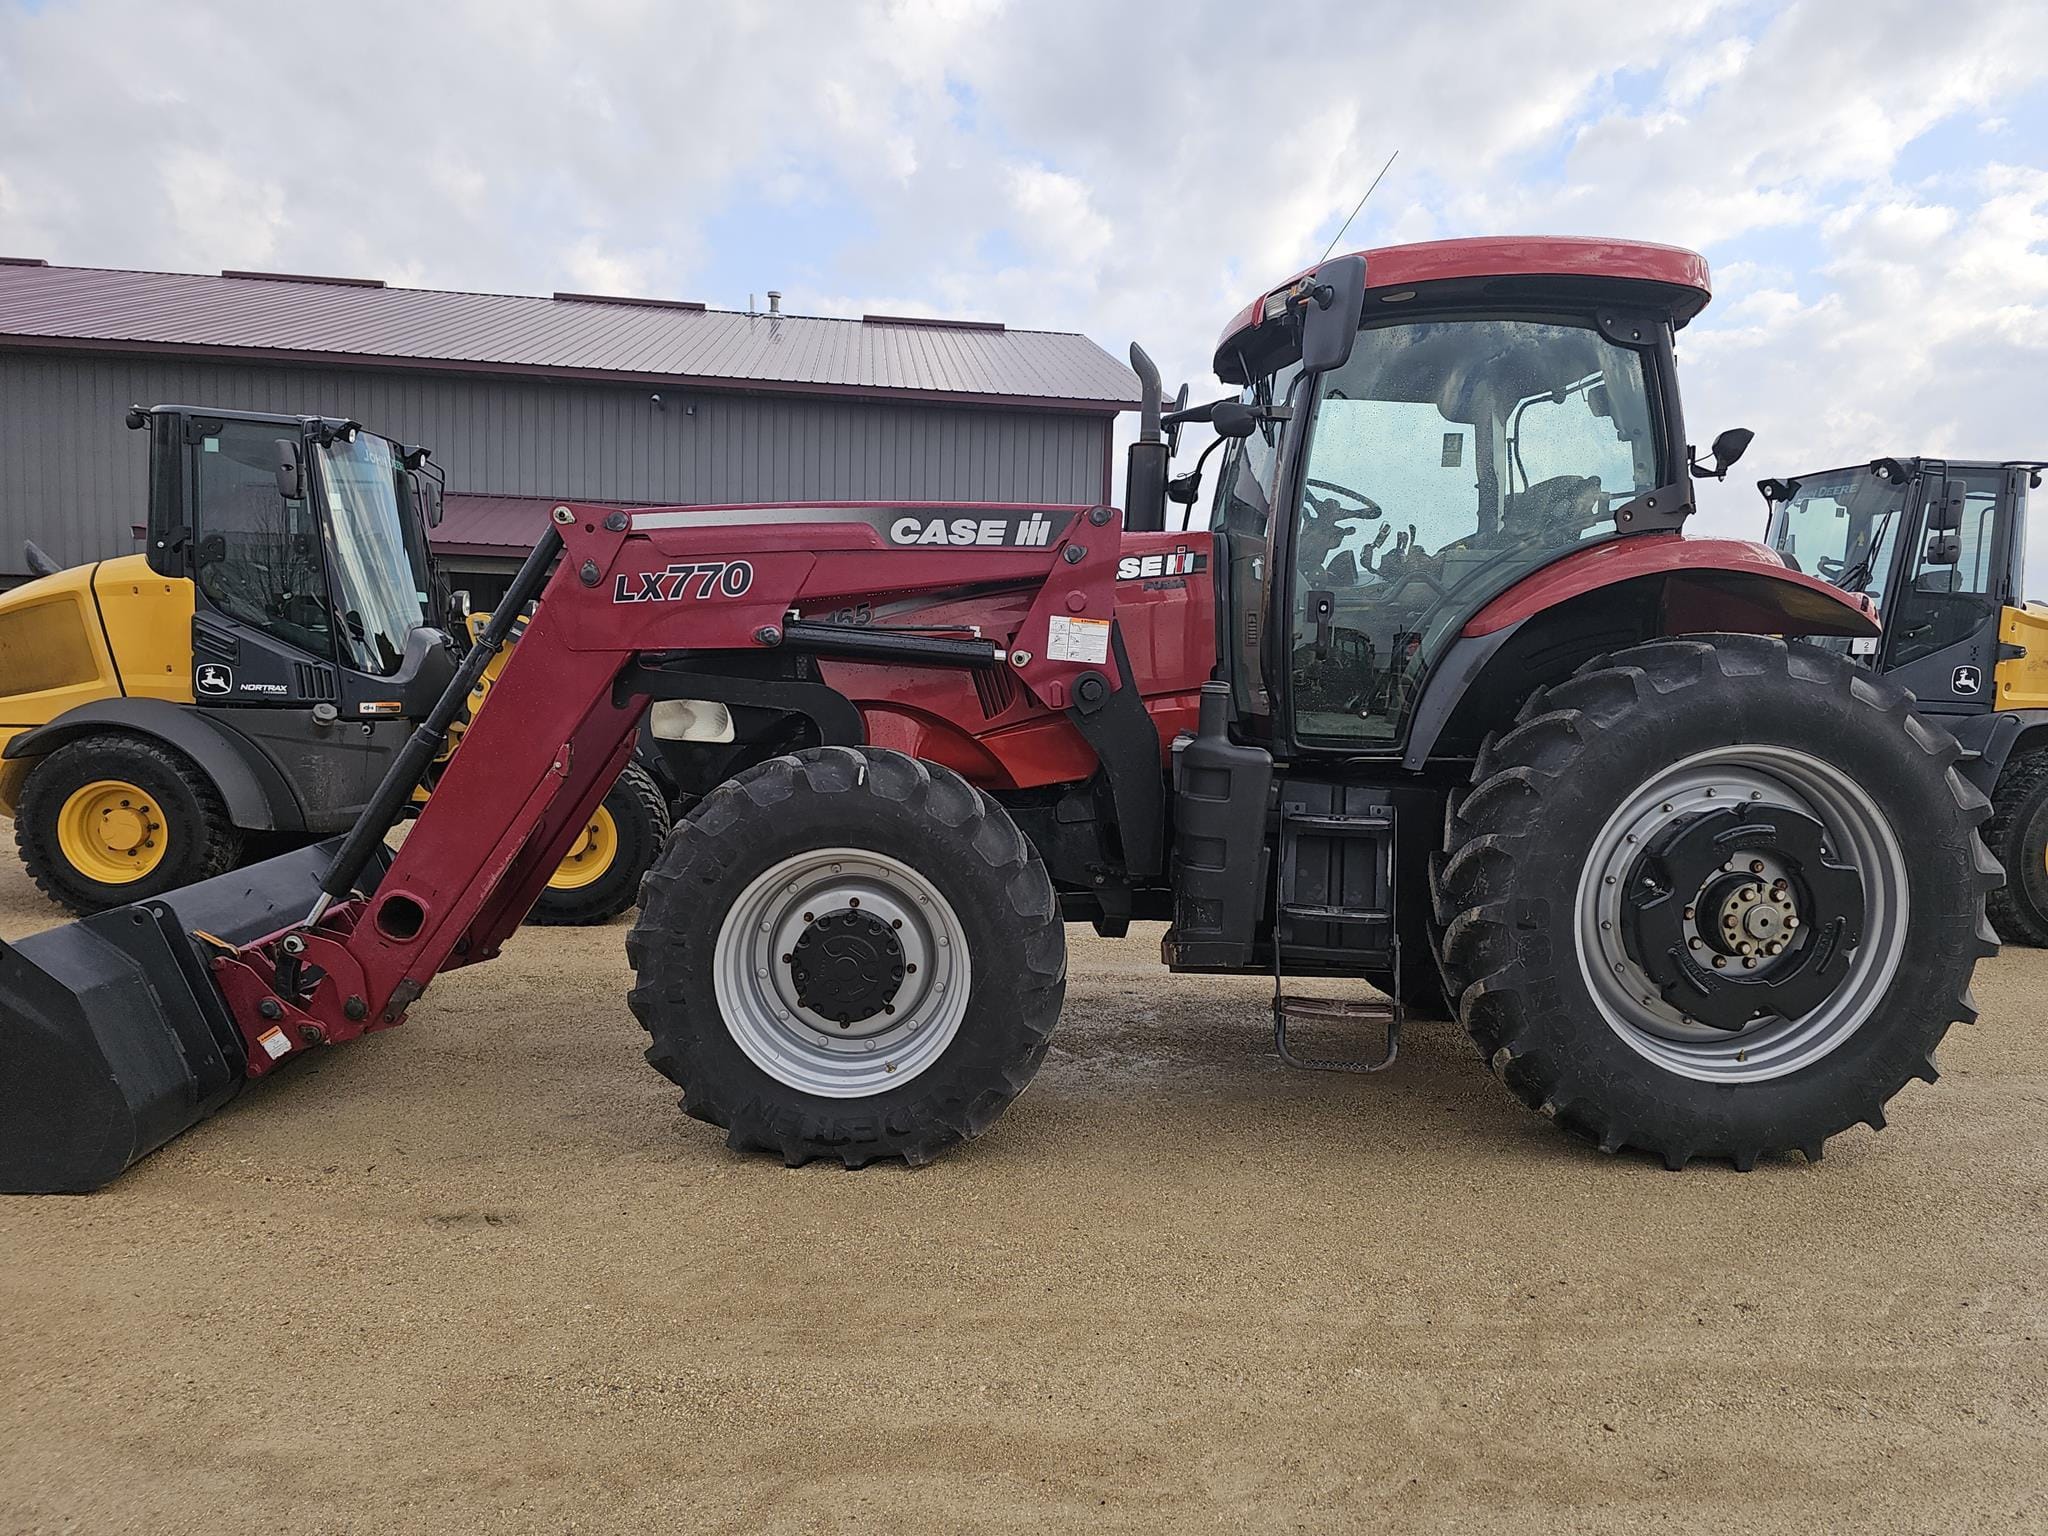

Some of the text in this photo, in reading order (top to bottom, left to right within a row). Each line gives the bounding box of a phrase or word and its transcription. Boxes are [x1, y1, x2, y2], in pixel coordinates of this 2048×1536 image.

[1818, 483, 1859, 497] DEERE
[890, 517, 1008, 545] CASE
[1116, 555, 1163, 580] SE
[613, 560, 754, 604] LX770
[240, 683, 288, 692] NORTRAX
